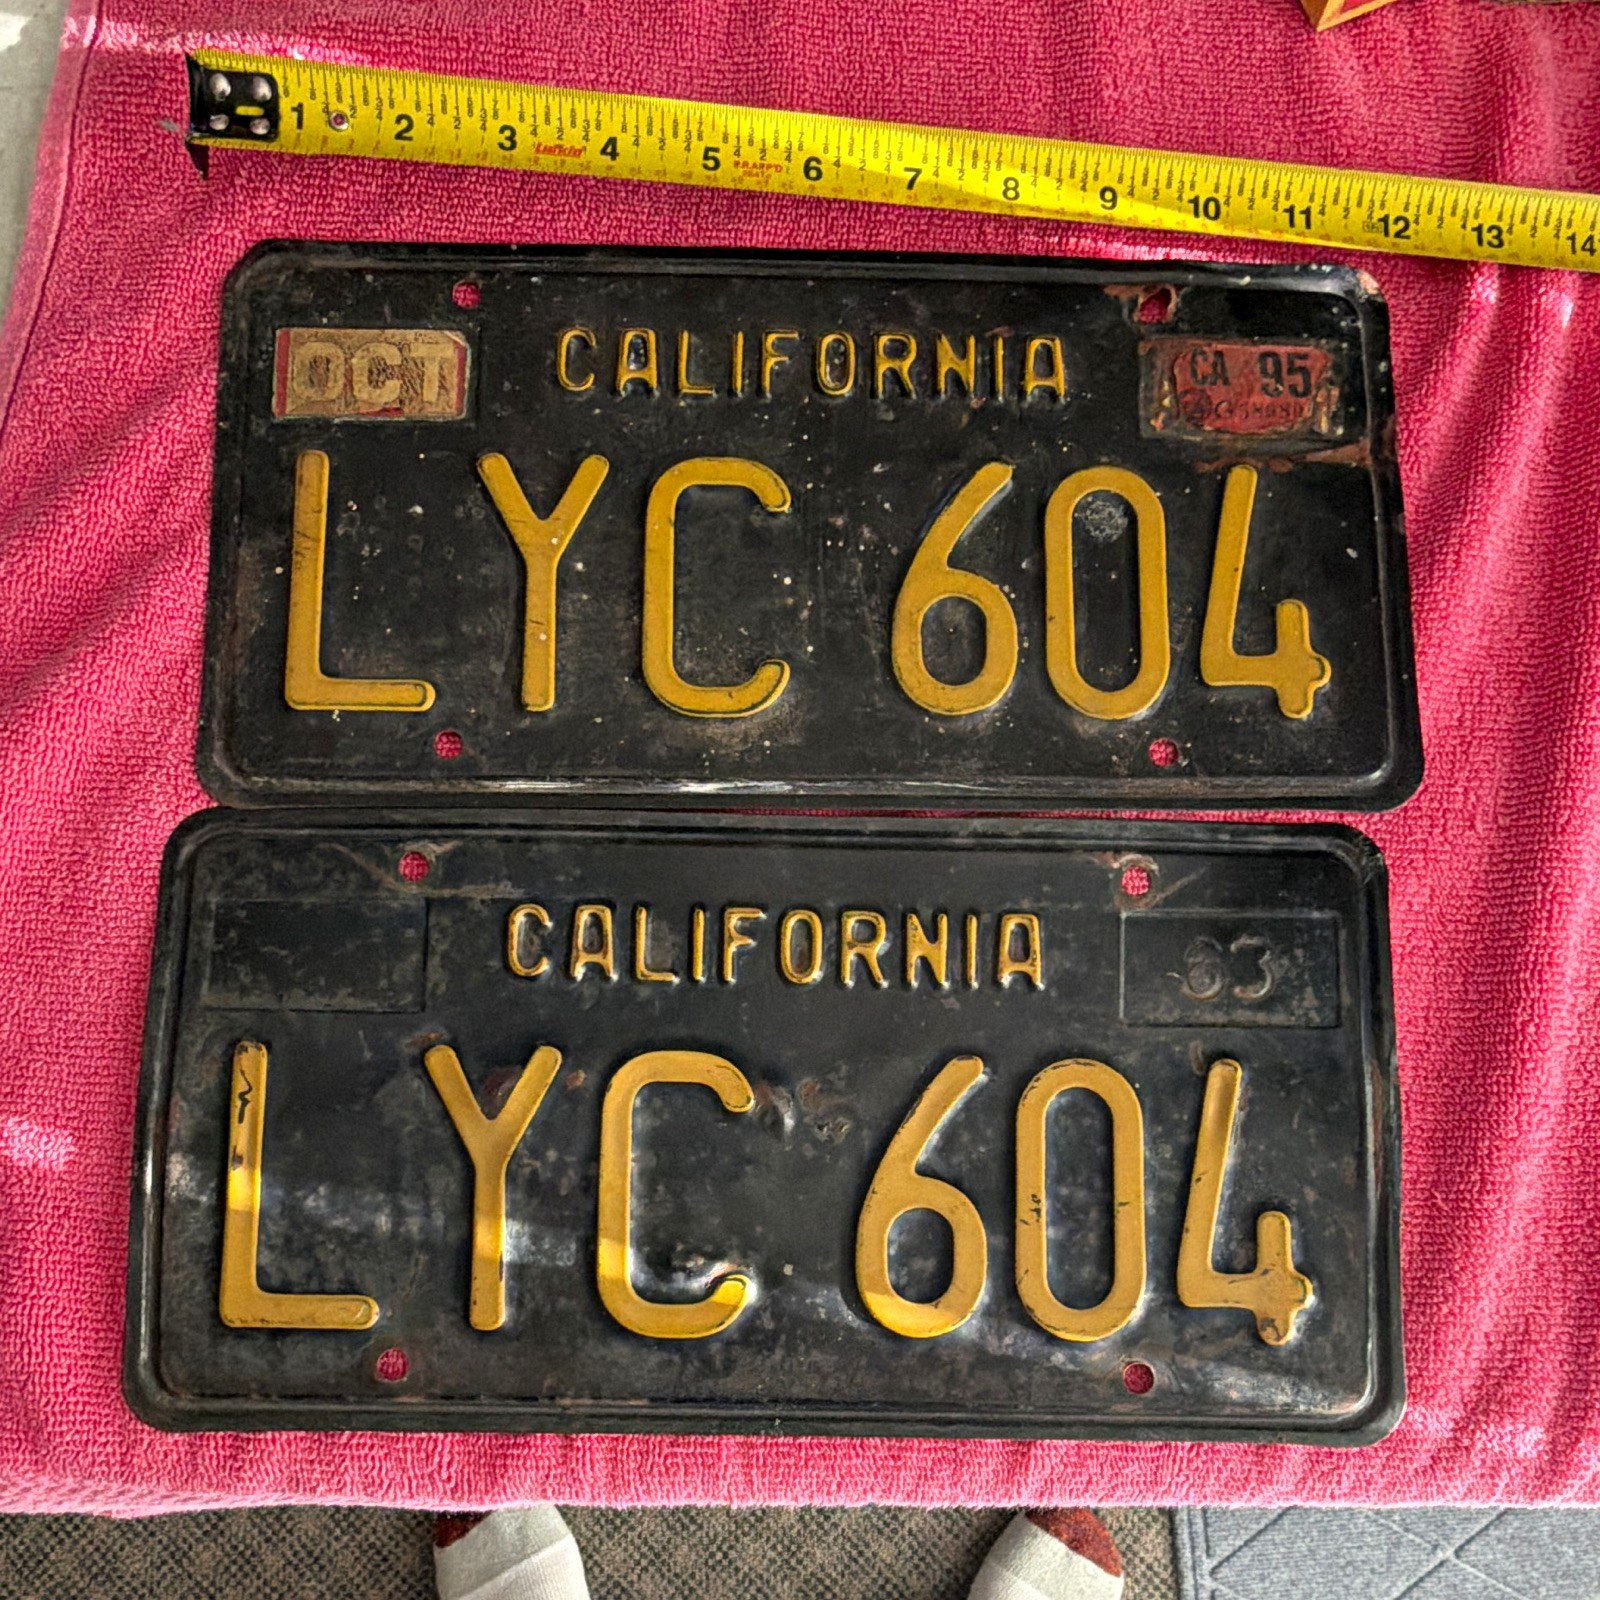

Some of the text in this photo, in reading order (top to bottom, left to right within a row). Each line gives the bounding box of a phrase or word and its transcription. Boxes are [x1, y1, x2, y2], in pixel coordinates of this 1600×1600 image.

[290, 101, 304, 130] 1
[394, 113, 414, 141] 2
[497, 124, 518, 152] 3
[599, 136, 619, 162] 4
[702, 146, 721, 171] 5
[803, 156, 823, 182] 6
[903, 166, 923, 191] 7
[1001, 176, 1020, 202] 8
[1099, 185, 1118, 210] 9
[1187, 195, 1222, 221] 10
[1282, 204, 1312, 231] 11
[1377, 213, 1412, 240] 12
[1471, 223, 1505, 249] 13
[1565, 232, 1597, 257] 14
[292, 341, 456, 404] OCT
[555, 326, 1069, 400] CALIFORNIA
[1189, 346, 1313, 399] CA 95
[284, 449, 1333, 722] LYC 604
[506, 901, 1048, 992] CALIFORNIA
[218, 1039, 1318, 1348] LYC 604
